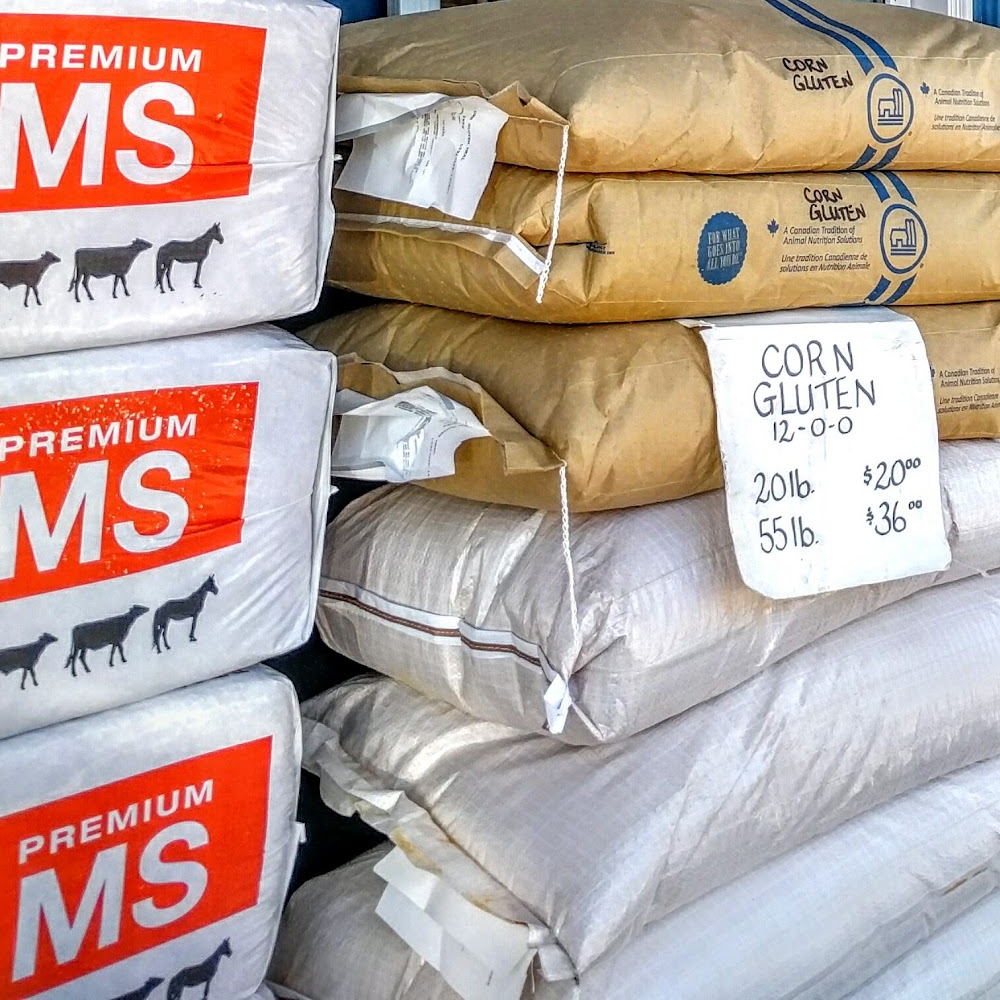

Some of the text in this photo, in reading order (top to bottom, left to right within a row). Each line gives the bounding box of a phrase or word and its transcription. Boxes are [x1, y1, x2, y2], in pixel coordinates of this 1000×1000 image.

[0, 43, 202, 72] PREMIUM
[782, 56, 828, 73] CORN
[792, 70, 854, 92] GLUTEN
[0, 81, 196, 190] MS
[803, 187, 843, 204] CORN
[809, 203, 867, 222] GLUTEN
[721, 227, 740, 241] WHAT
[789, 226, 820, 234] Canadian
[821, 226, 848, 234] Tradition
[848, 225, 856, 235] of
[706, 243, 725, 255] GOES
[782, 236, 863, 245] Animal Nutrition Solutions
[706, 257, 719, 270] ALL
[781, 253, 868, 262] Une tradition Canadienne de
[779, 264, 809, 273] solutions
[819, 263, 847, 272] Nutrition
[847, 262, 871, 271] Animale
[761, 339, 855, 379] CORN
[944, 369, 968, 378] Canadian
[969, 368, 990, 376] Tradition
[940, 379, 958, 388] Animal
[959, 378, 982, 386] Nutrition
[753, 377, 877, 418] GLUTEN
[0, 413, 197, 462] PREMIUM
[772, 415, 853, 443] 12-0-0
[0, 449, 191, 581] MS
[18, 779, 214, 865] PREMIUM
[11, 820, 210, 983] MS
